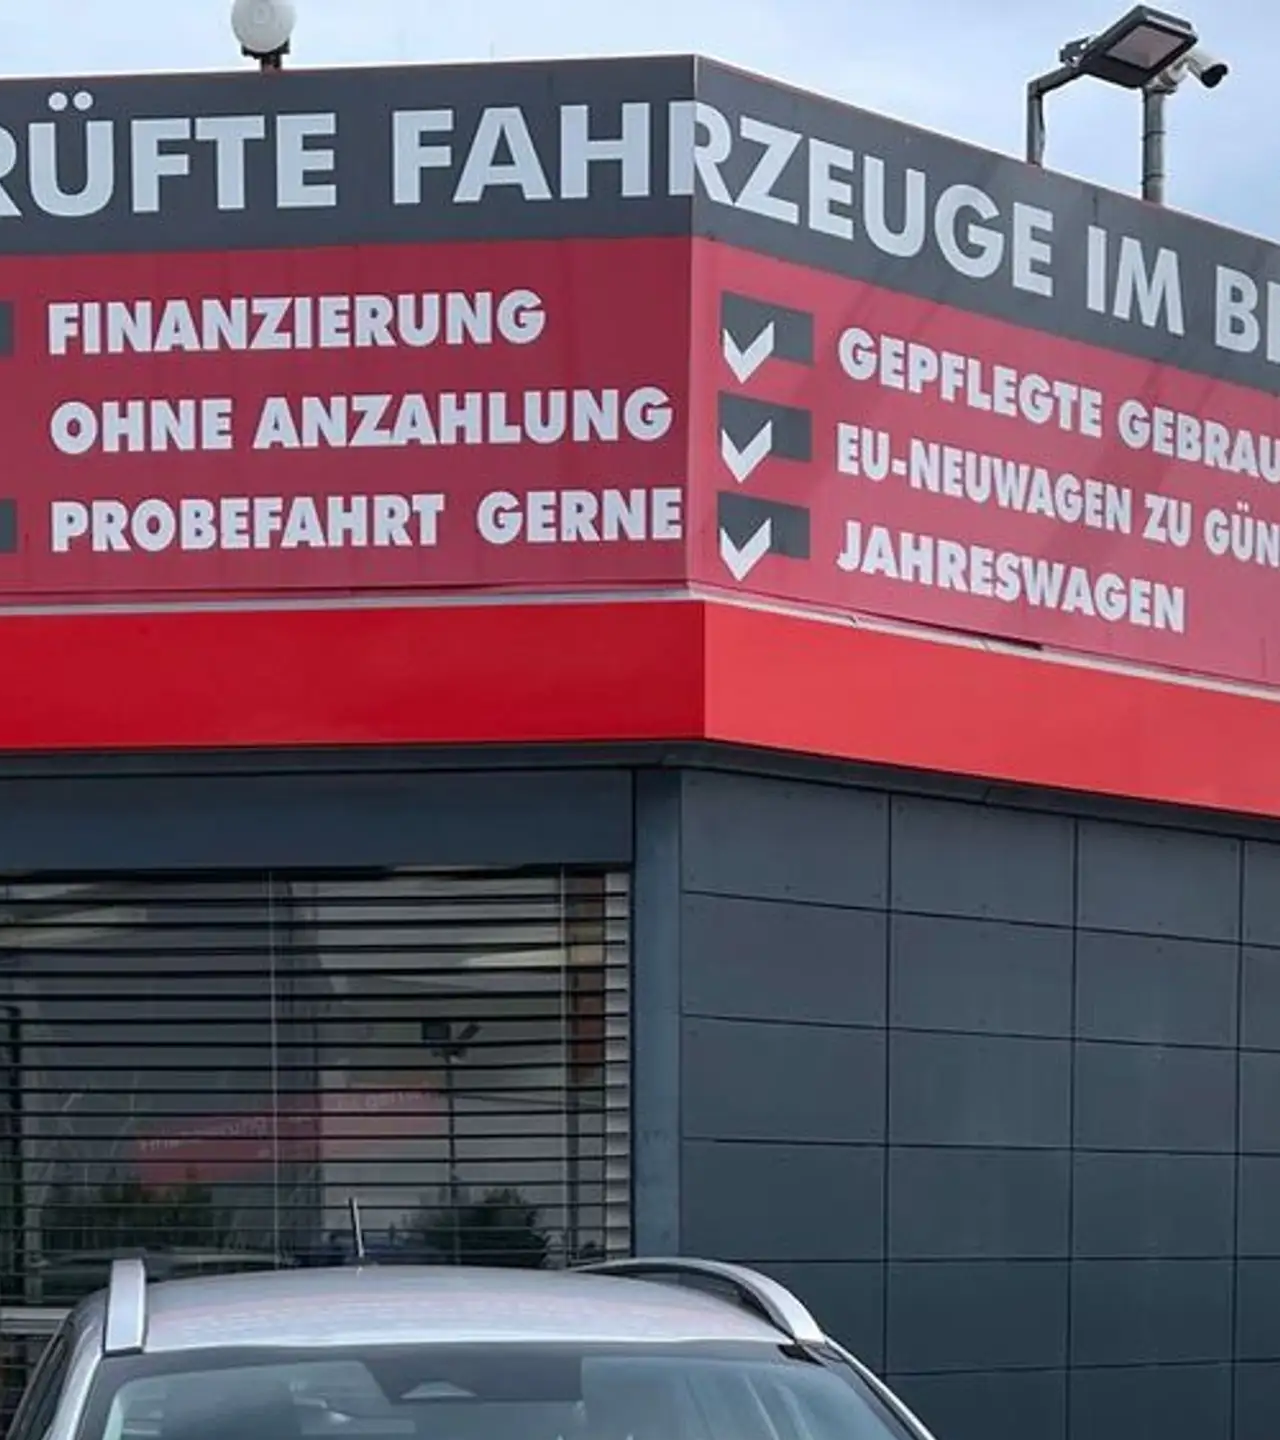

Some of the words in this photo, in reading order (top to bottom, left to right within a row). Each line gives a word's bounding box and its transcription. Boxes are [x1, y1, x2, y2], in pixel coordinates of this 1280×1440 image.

[392, 101, 1054, 298] FAHRZEUGE
[1086, 225, 1184, 335] IM
[47, 290, 547, 356] FINANZIERUNG
[50, 401, 233, 456] OHNE
[253, 388, 673, 451] ANZAHLUNG
[837, 327, 1103, 438] GEPFLEGTE
[50, 494, 445, 553] PROBEFAHRT
[477, 488, 682, 545] GERNE
[836, 422, 1132, 535] EU-NEUWAGEN
[1143, 495, 1193, 546] ZU
[837, 522, 1185, 634] JAHRESWAGEN
